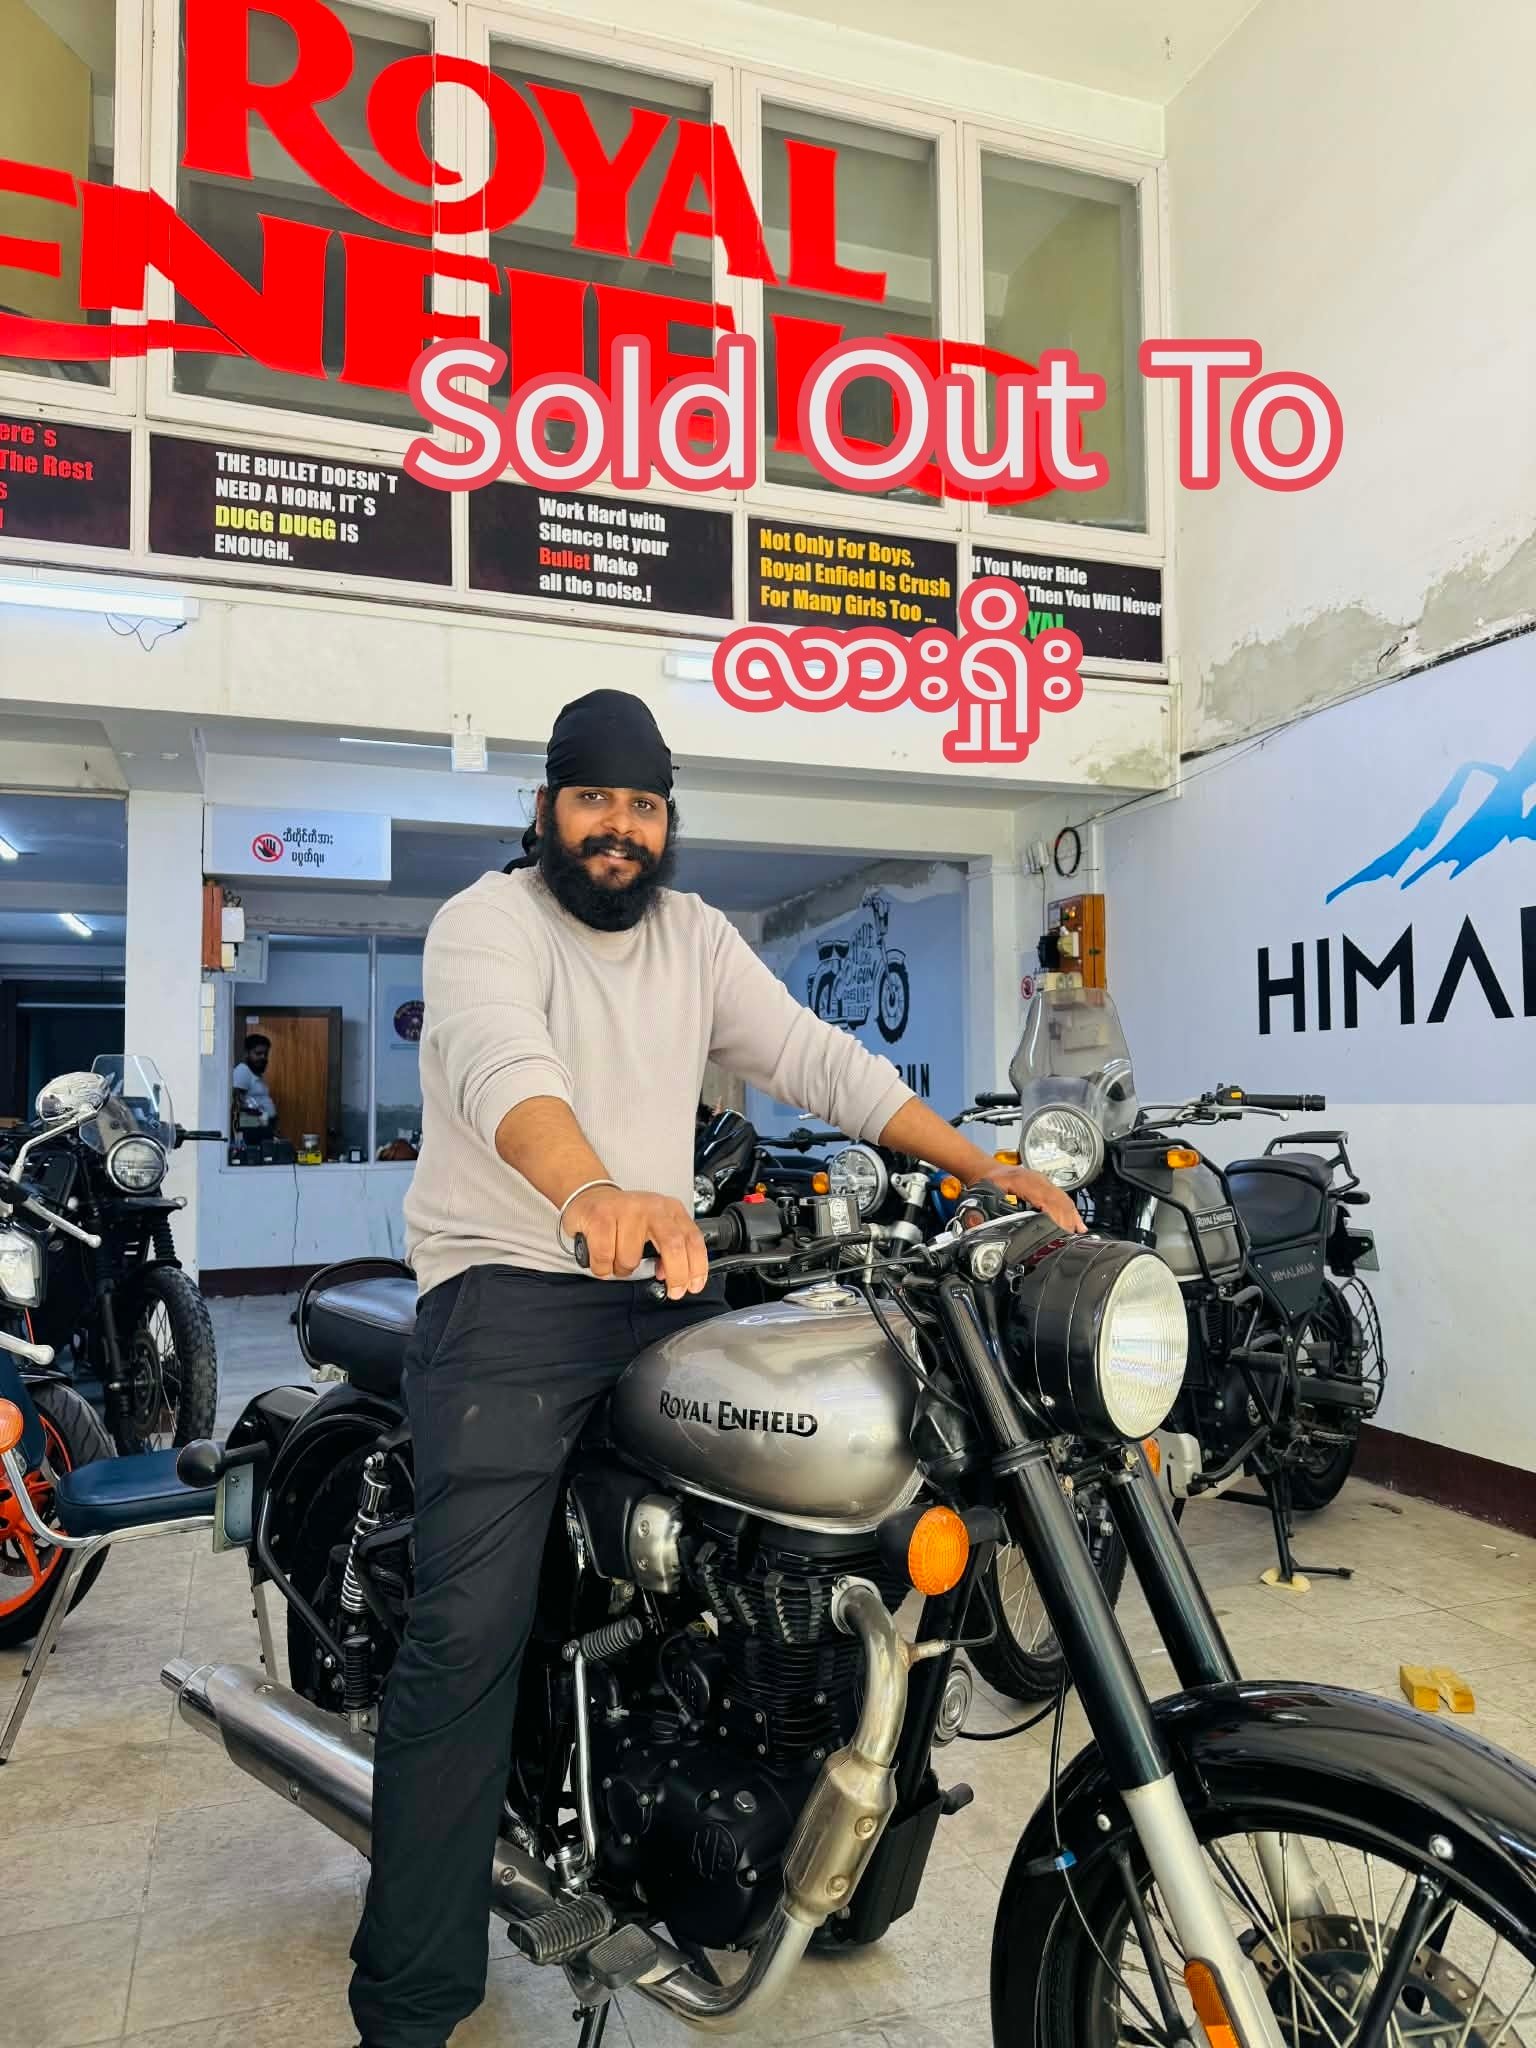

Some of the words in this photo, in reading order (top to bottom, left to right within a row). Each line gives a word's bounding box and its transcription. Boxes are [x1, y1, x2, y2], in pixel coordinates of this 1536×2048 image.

[181, 0, 887, 303] ROYAL
[43, 454, 94, 481] Rest
[216, 451, 250, 475] THE
[254, 456, 317, 483] BULLET
[215, 477, 261, 503] NEED
[265, 482, 278, 504] A
[281, 485, 336, 514] HORN,
[538, 495, 586, 523] Work
[587, 502, 628, 529] Hard
[630, 509, 666, 533] with
[215, 505, 274, 534] DUGG
[279, 511, 337, 542] DUGG
[340, 520, 359, 544] IS
[538, 522, 605, 550] Silence
[607, 531, 630, 553] let
[632, 537, 670, 559] your
[215, 532, 294, 562] ENOUGH.
[539, 547, 592, 572] Bullet
[593, 553, 638, 578] Make
[760, 527, 792, 553] Not
[794, 531, 834, 559] Only
[837, 536, 866, 561] For
[868, 540, 916, 569] Boys,
[539, 573, 562, 595] all
[565, 575, 593, 598] the
[760, 556, 812, 585] Royal
[815, 561, 877, 591] Enfield
[879, 569, 896, 592] Is
[899, 572, 951, 599] Crush
[983, 557, 1010, 577] You
[1012, 560, 1054, 582] Never
[1055, 566, 1088, 586] Ride
[760, 584, 790, 609] For
[792, 588, 842, 617] Many
[845, 594, 888, 620] Girls
[889, 600, 923, 624] Too
[1028, 585, 1064, 606] Then
[1065, 589, 1091, 609] You
[1092, 593, 1121, 613] Will
[1122, 597, 1162, 617] Never
[660, 1390, 712, 1424] ROYAL
[718, 1401, 818, 1438] ENFIELD
